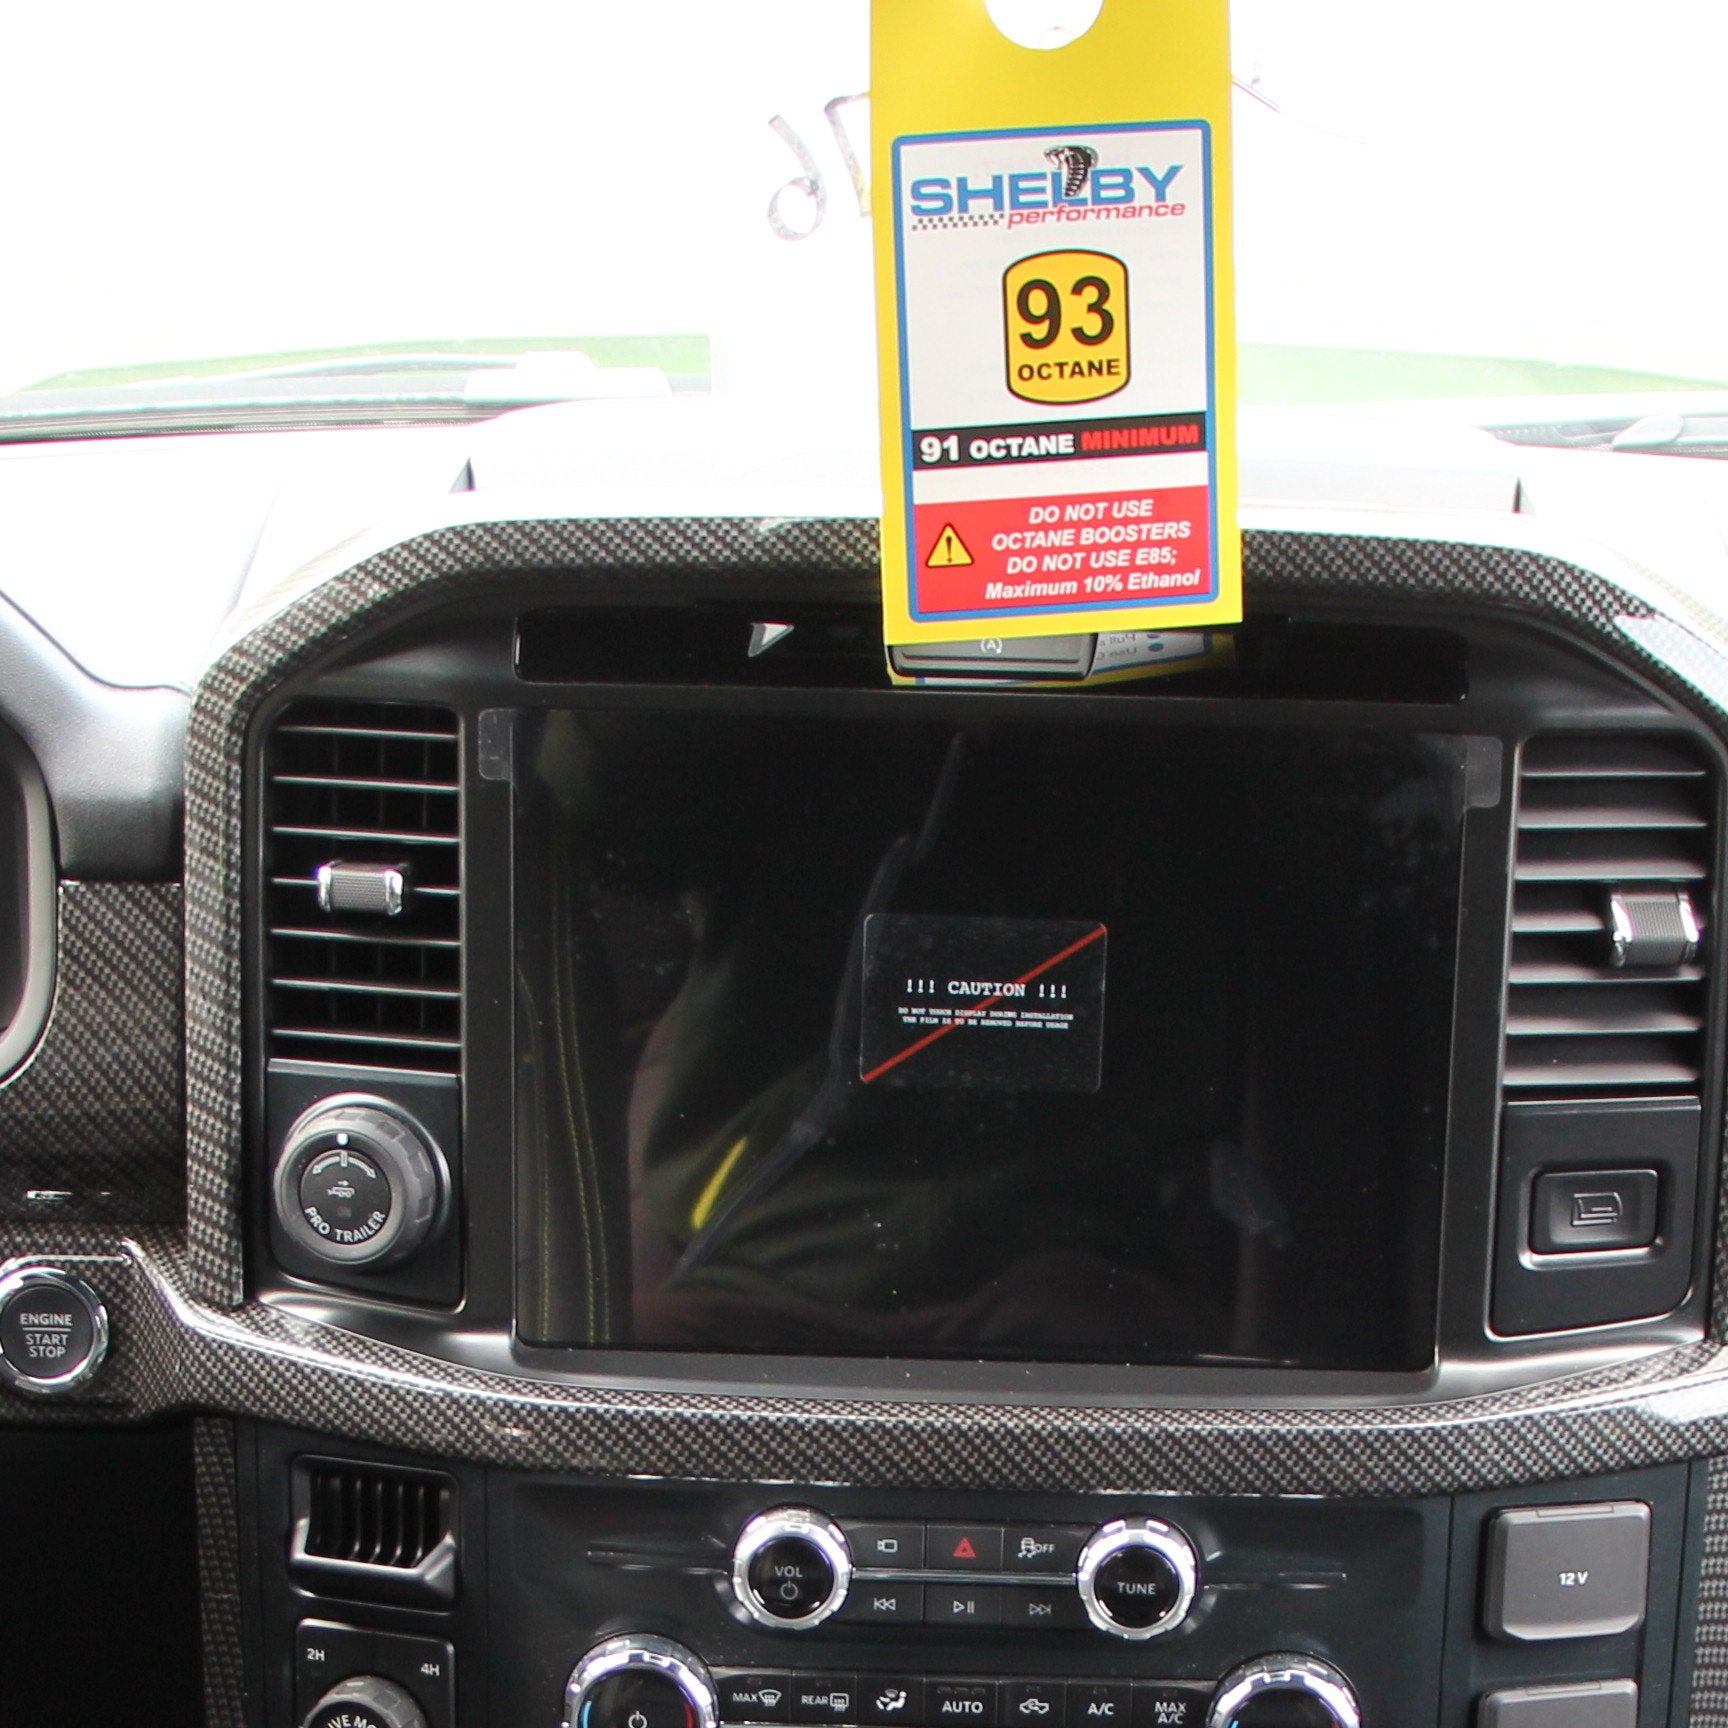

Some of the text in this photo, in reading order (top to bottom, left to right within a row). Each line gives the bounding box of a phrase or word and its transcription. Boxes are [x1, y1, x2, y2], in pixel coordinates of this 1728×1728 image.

[910, 164, 1184, 217] SHELBY
[1007, 203, 1186, 229] performance
[1016, 276, 1114, 349] 93
[1018, 358, 1121, 382] OCTANE
[920, 424, 1199, 463] 91 OCTANE MINIMUM
[1029, 500, 1153, 523] DO NOT USE
[992, 521, 1192, 550] OCTANE BOOSTERS
[1007, 557, 1036, 574] DO
[1042, 554, 1084, 571] NOT
[1090, 551, 1130, 569] USE
[985, 569, 1201, 600] Maximum 10% Ethanol
[947, 981, 1026, 997] CAUTION
[955, 1009, 986, 1018] DISPLAY
[304, 1206, 386, 1242] PRO TRAILER
[19, 1313, 73, 1327] ENGINE
[25, 1333, 69, 1347] START
[28, 1345, 67, 1359] STOP
[1035, 1542, 1056, 1554] OFF
[774, 1565, 802, 1578] VOL
[1116, 1582, 1156, 1596] TUNE
[307, 1648, 325, 1661] 2H
[421, 1663, 440, 1676] 4H
[732, 1692, 759, 1703] MAX
[801, 1695, 829, 1705] REAR
[942, 1699, 983, 1715] AUTO
[1087, 1702, 1115, 1717] A/C
[1155, 1702, 1187, 1714] MAX
[1157, 1712, 1184, 1725] A/C
